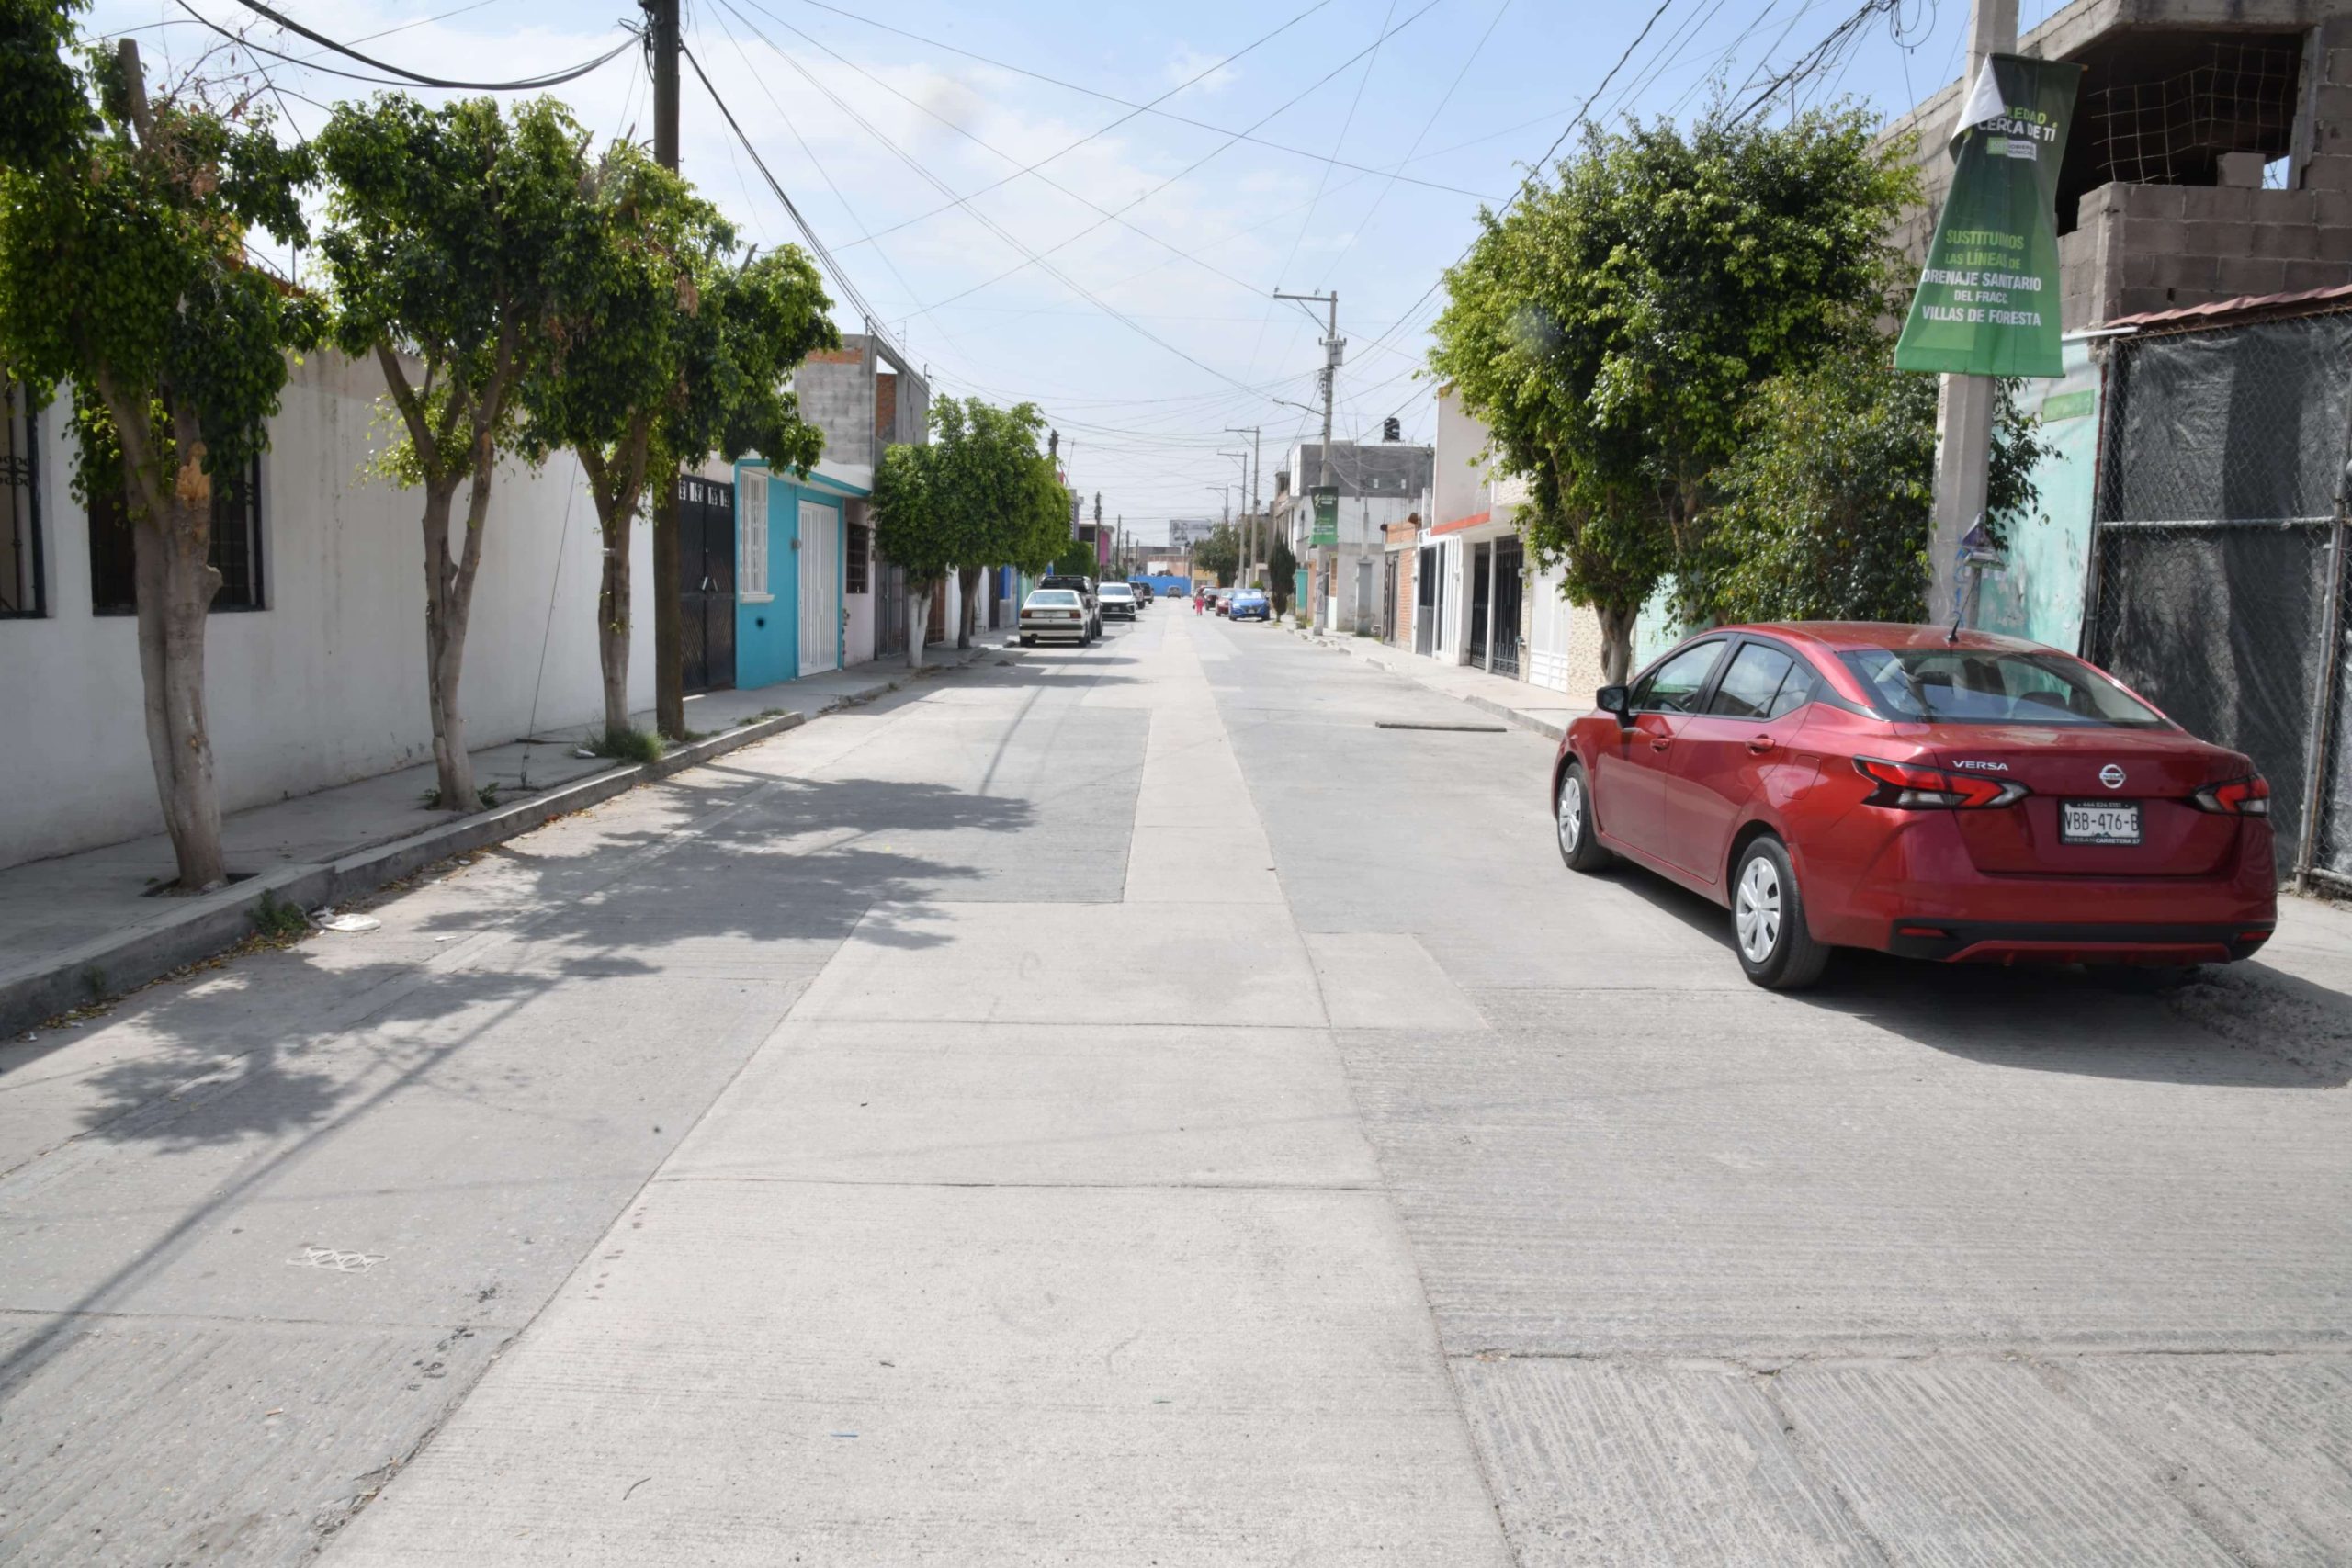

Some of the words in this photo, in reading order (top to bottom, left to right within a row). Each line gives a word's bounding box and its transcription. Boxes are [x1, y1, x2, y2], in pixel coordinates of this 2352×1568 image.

[1977, 117, 2024, 135] CERCA
[2027, 122, 2041, 140] DE
[1944, 253, 1964, 265] LAS
[2008, 258, 2021, 270] DE
[1920, 269, 1979, 286] DRENAJE
[1954, 289, 1973, 302] DEL
[1922, 306, 1965, 322] VILLAS
[1967, 308, 1985, 323] DE
[1988, 310, 2041, 326] FORESTA
[1952, 760, 2009, 772] VERSA
[2065, 811, 2138, 831] VBB-476-B
